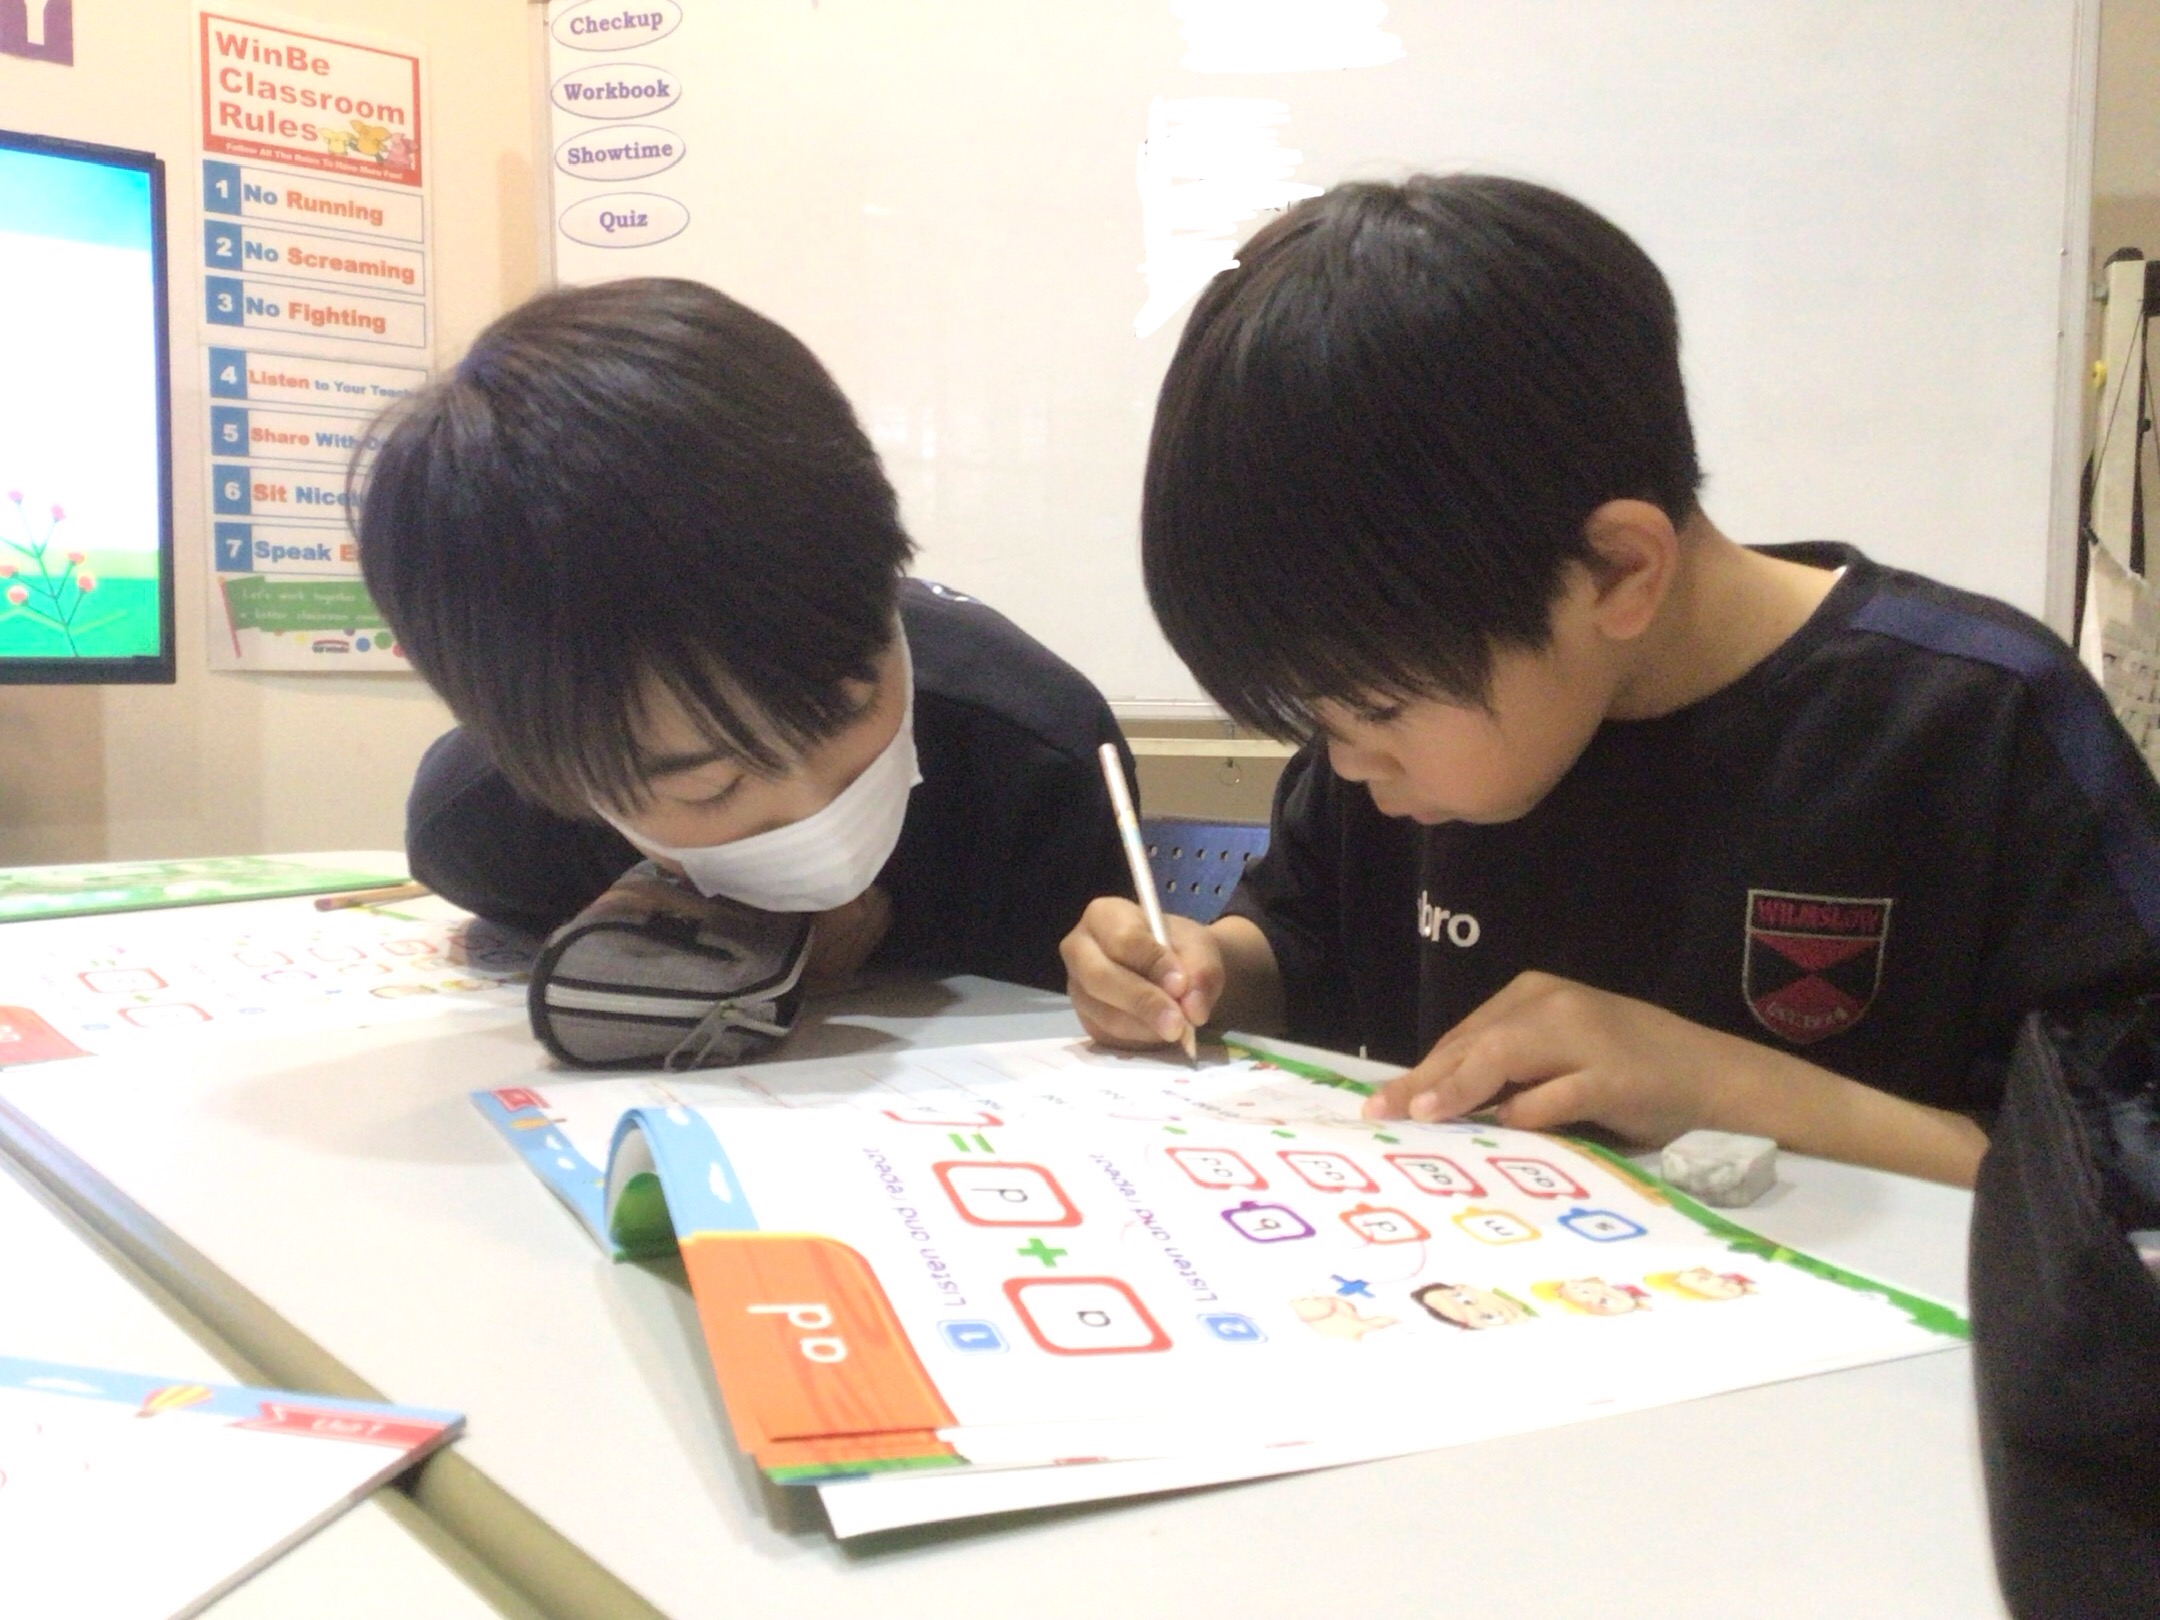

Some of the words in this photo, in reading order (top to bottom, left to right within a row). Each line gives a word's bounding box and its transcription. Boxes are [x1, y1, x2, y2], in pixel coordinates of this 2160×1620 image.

[569, 11, 664, 35] Checkup
[215, 31, 331, 76] WinBe
[218, 67, 406, 125] Classroom
[563, 79, 671, 101] Workbook
[218, 101, 320, 142] Rules
[567, 142, 674, 165] Showtime
[215, 179, 228, 199] 1
[243, 183, 278, 206] No
[286, 189, 384, 227] Running
[599, 210, 649, 233] Quiz
[215, 236, 233, 257] 2
[244, 240, 279, 263] No
[286, 246, 416, 286] Screaming
[216, 293, 233, 313] 3
[246, 296, 281, 318] No
[288, 301, 387, 335] Fighting
[219, 365, 238, 386] 4
[248, 369, 310, 390] Listen
[314, 379, 330, 392] to
[333, 380, 367, 396] Your
[369, 383, 418, 399] Teach
[222, 423, 239, 443] 5
[250, 427, 311, 447] Share
[223, 481, 241, 501] 6
[252, 482, 287, 503] Sit
[295, 484, 363, 507] Nice
[225, 538, 243, 559] 7
[253, 539, 332, 564] Speak
[1417, 889, 1481, 948] bro
[1404, 1161, 1453, 1186] ad
[1506, 1164, 1556, 1189] ad
[970, 1186, 1028, 1204] d
[890, 1206, 931, 1242] and
[1129, 1207, 1171, 1242] and
[1252, 1217, 1282, 1232] b
[919, 1247, 968, 1307] Listen
[1164, 1247, 1219, 1302] Listen
[1076, 1310, 1112, 1328] a
[1217, 1322, 1250, 1335] 2
[746, 1303, 848, 1364] ad
[958, 1329, 991, 1344] 1
